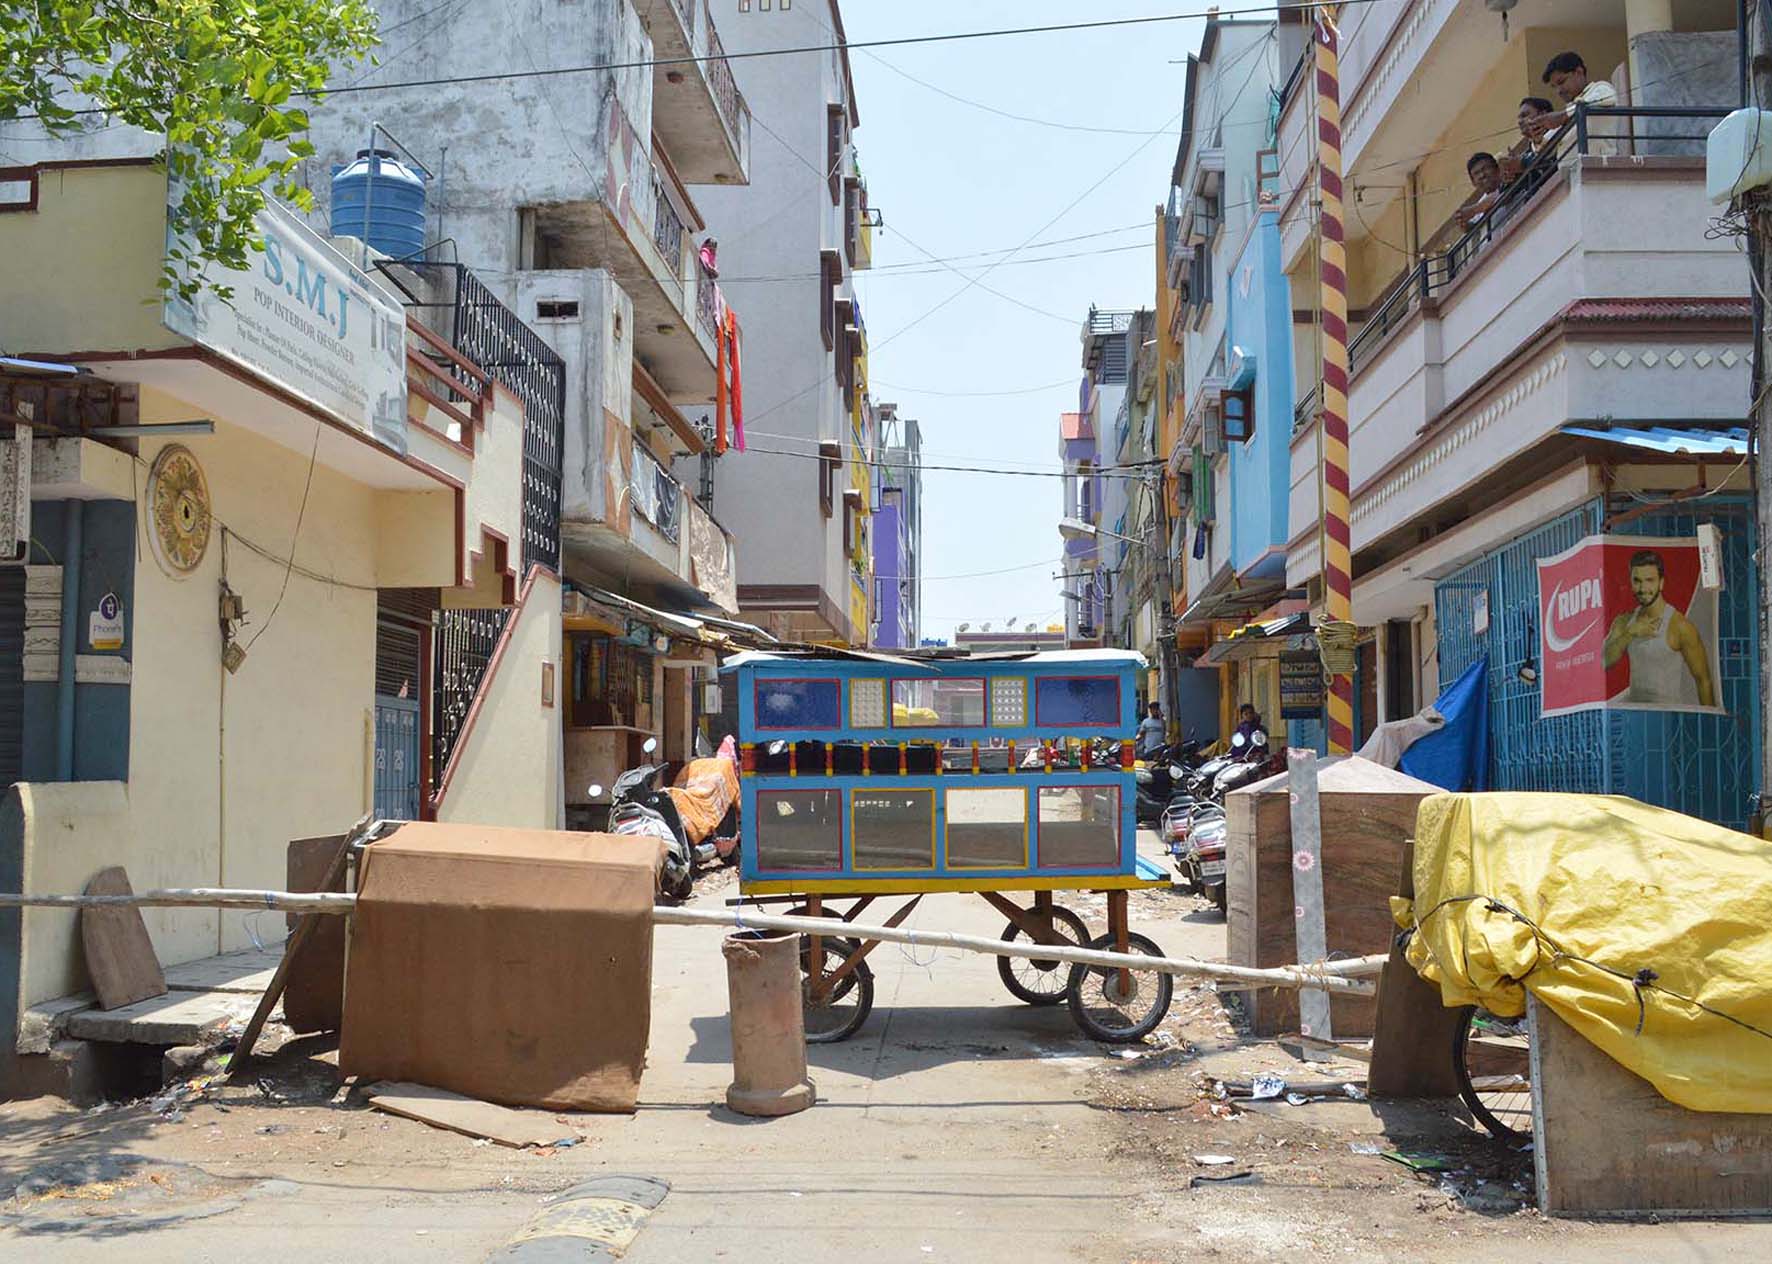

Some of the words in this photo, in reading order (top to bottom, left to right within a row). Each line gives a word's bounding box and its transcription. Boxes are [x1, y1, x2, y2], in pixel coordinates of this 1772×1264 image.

[254, 286, 272, 310] POP
[274, 300, 315, 342] INTERIOR
[317, 329, 354, 367] DESIGNER
[1558, 578, 1602, 621] RUPA
